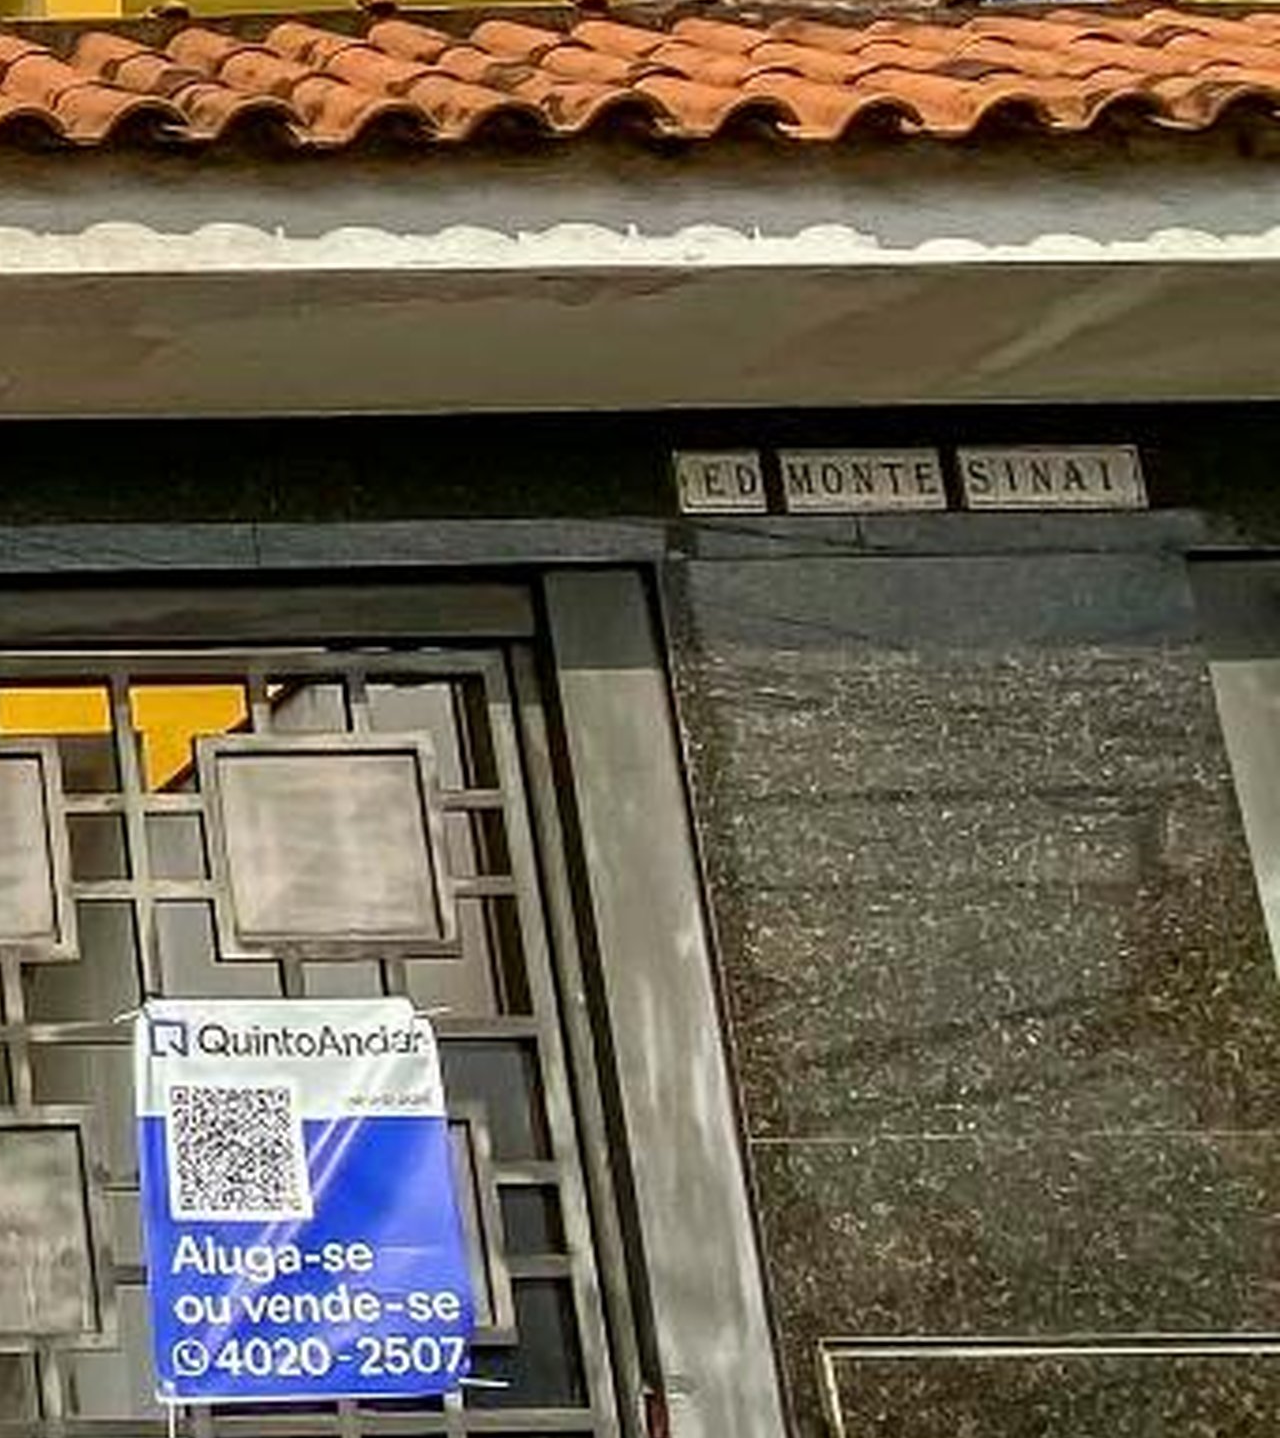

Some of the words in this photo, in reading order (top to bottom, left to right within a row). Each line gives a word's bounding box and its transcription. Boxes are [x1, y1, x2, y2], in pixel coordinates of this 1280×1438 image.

[788, 462, 939, 495] MONTE
[969, 462, 1118, 495] SINAI
[197, 1024, 425, 1057] QuintoAndar
[172, 1236, 373, 1283] Aluga-se
[174, 1296, 231, 1323] ou
[243, 1285, 460, 1323] vende-se
